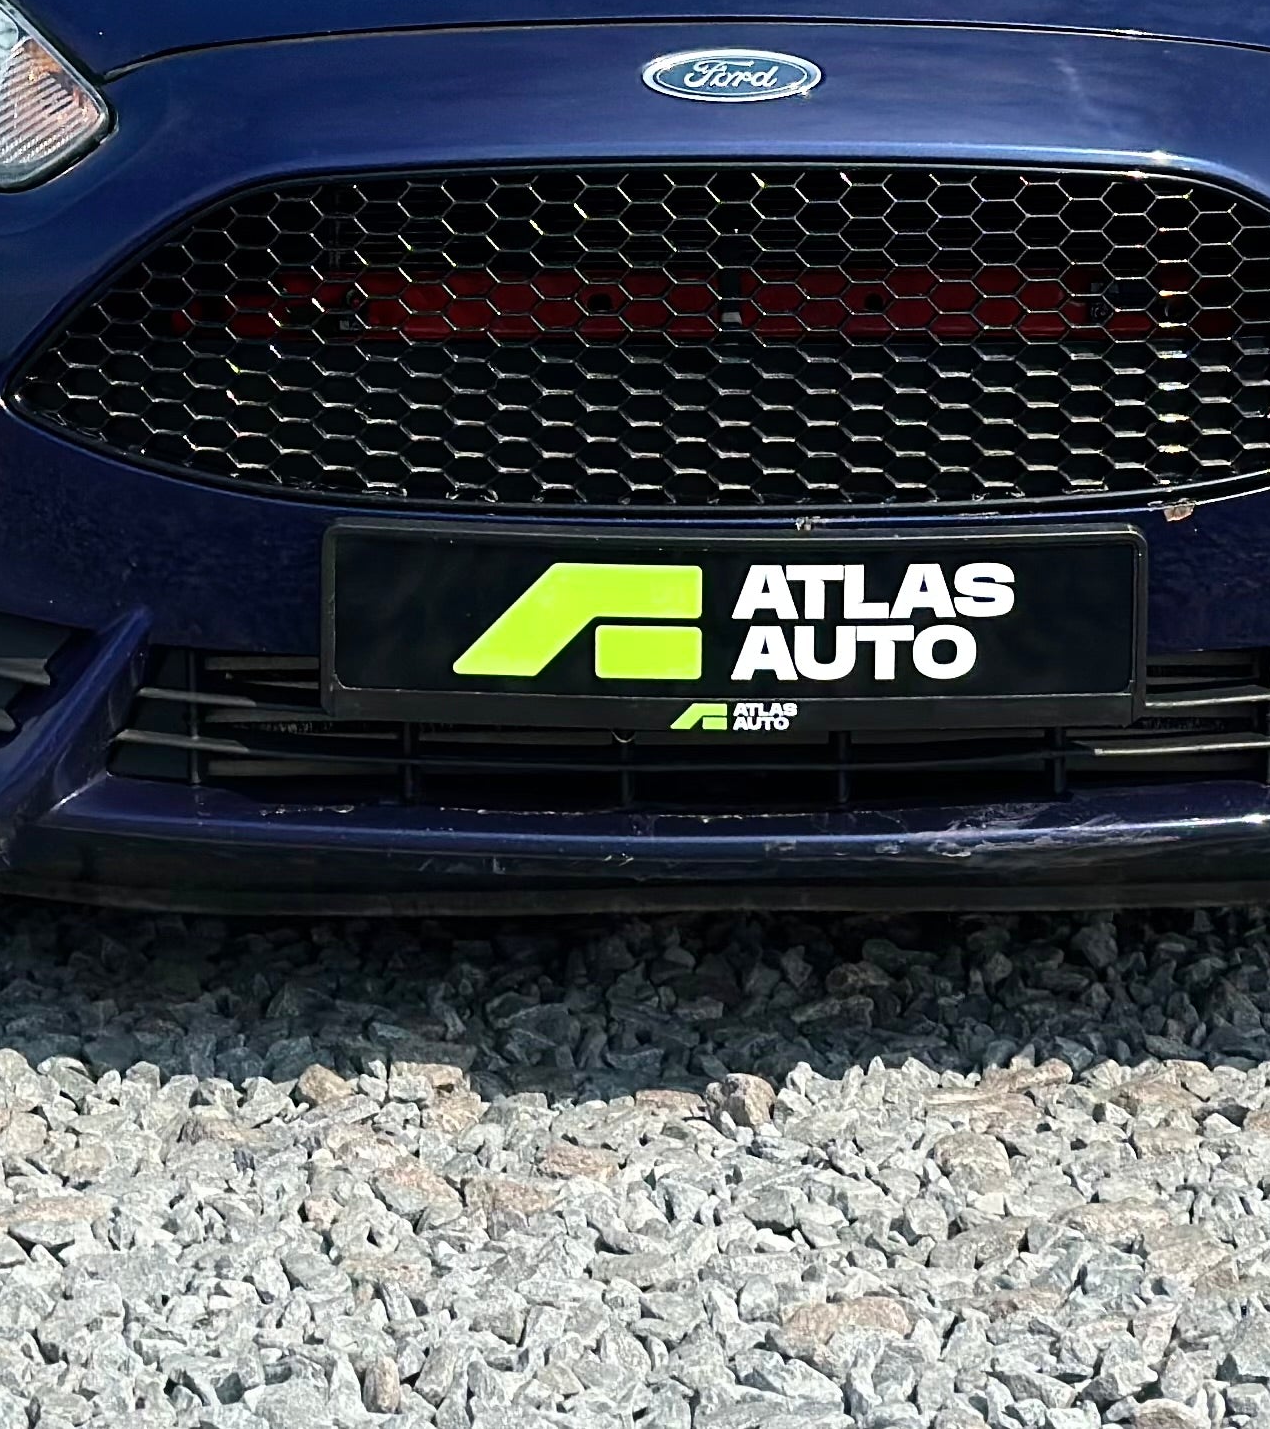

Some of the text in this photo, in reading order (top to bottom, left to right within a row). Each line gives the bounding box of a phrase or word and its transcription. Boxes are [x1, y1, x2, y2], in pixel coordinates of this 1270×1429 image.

[683, 60, 779, 88] Ford
[731, 562, 1016, 620] ATLAS
[730, 625, 977, 680] AUTO
[732, 702, 798, 717] ATLAS
[732, 716, 790, 731] AUTO
